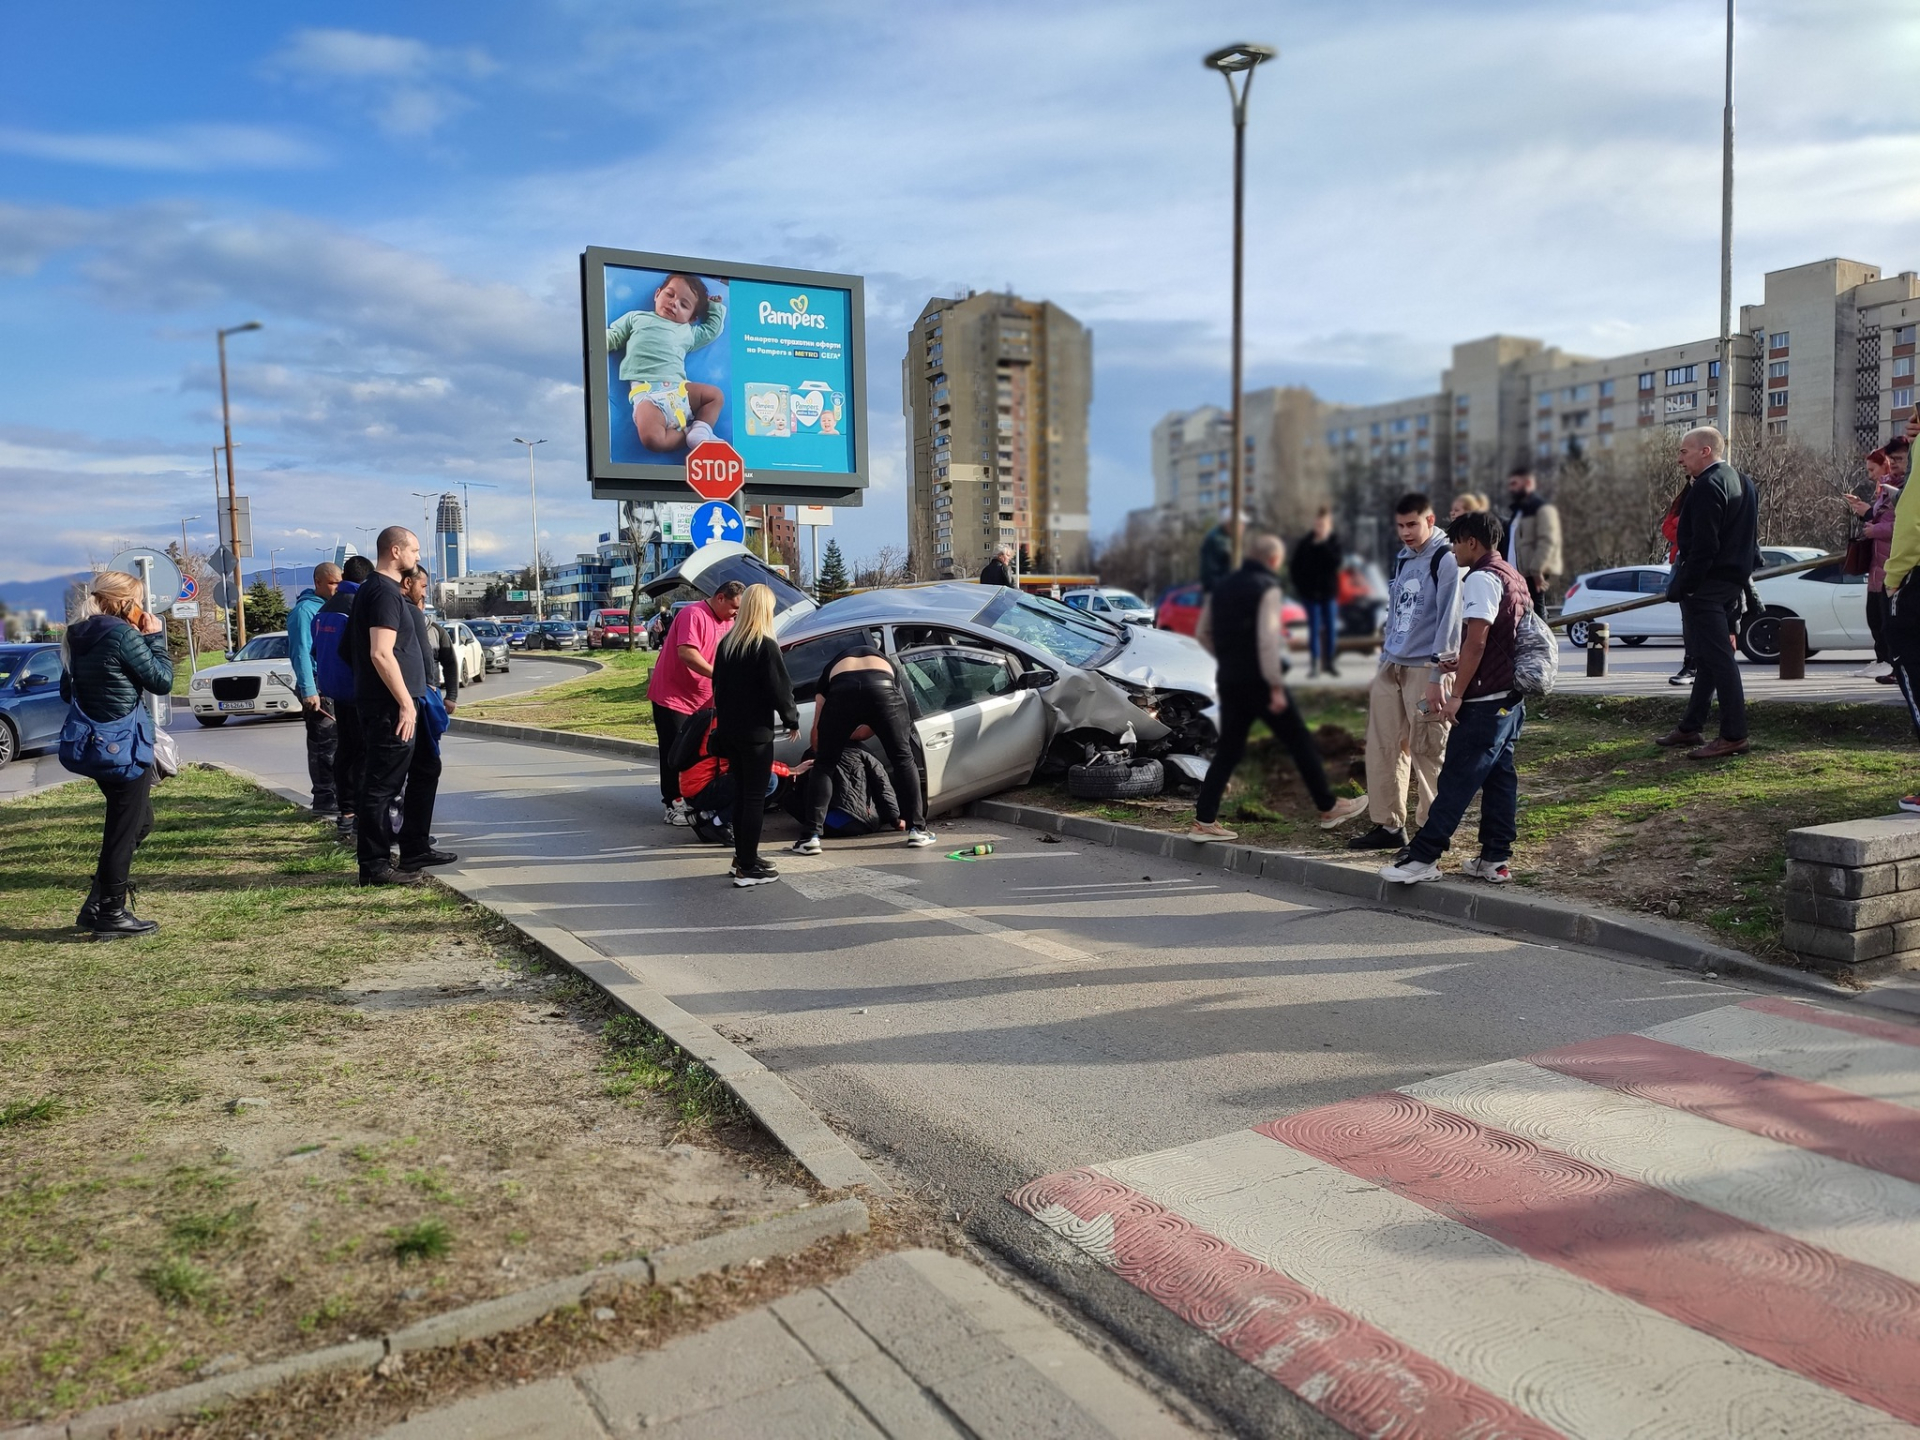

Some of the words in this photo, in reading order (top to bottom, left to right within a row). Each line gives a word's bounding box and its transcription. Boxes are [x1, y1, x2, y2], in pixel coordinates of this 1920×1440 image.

[758, 300, 826, 330] Pampers
[794, 350, 819, 358] METRO
[691, 459, 740, 482] STOP
